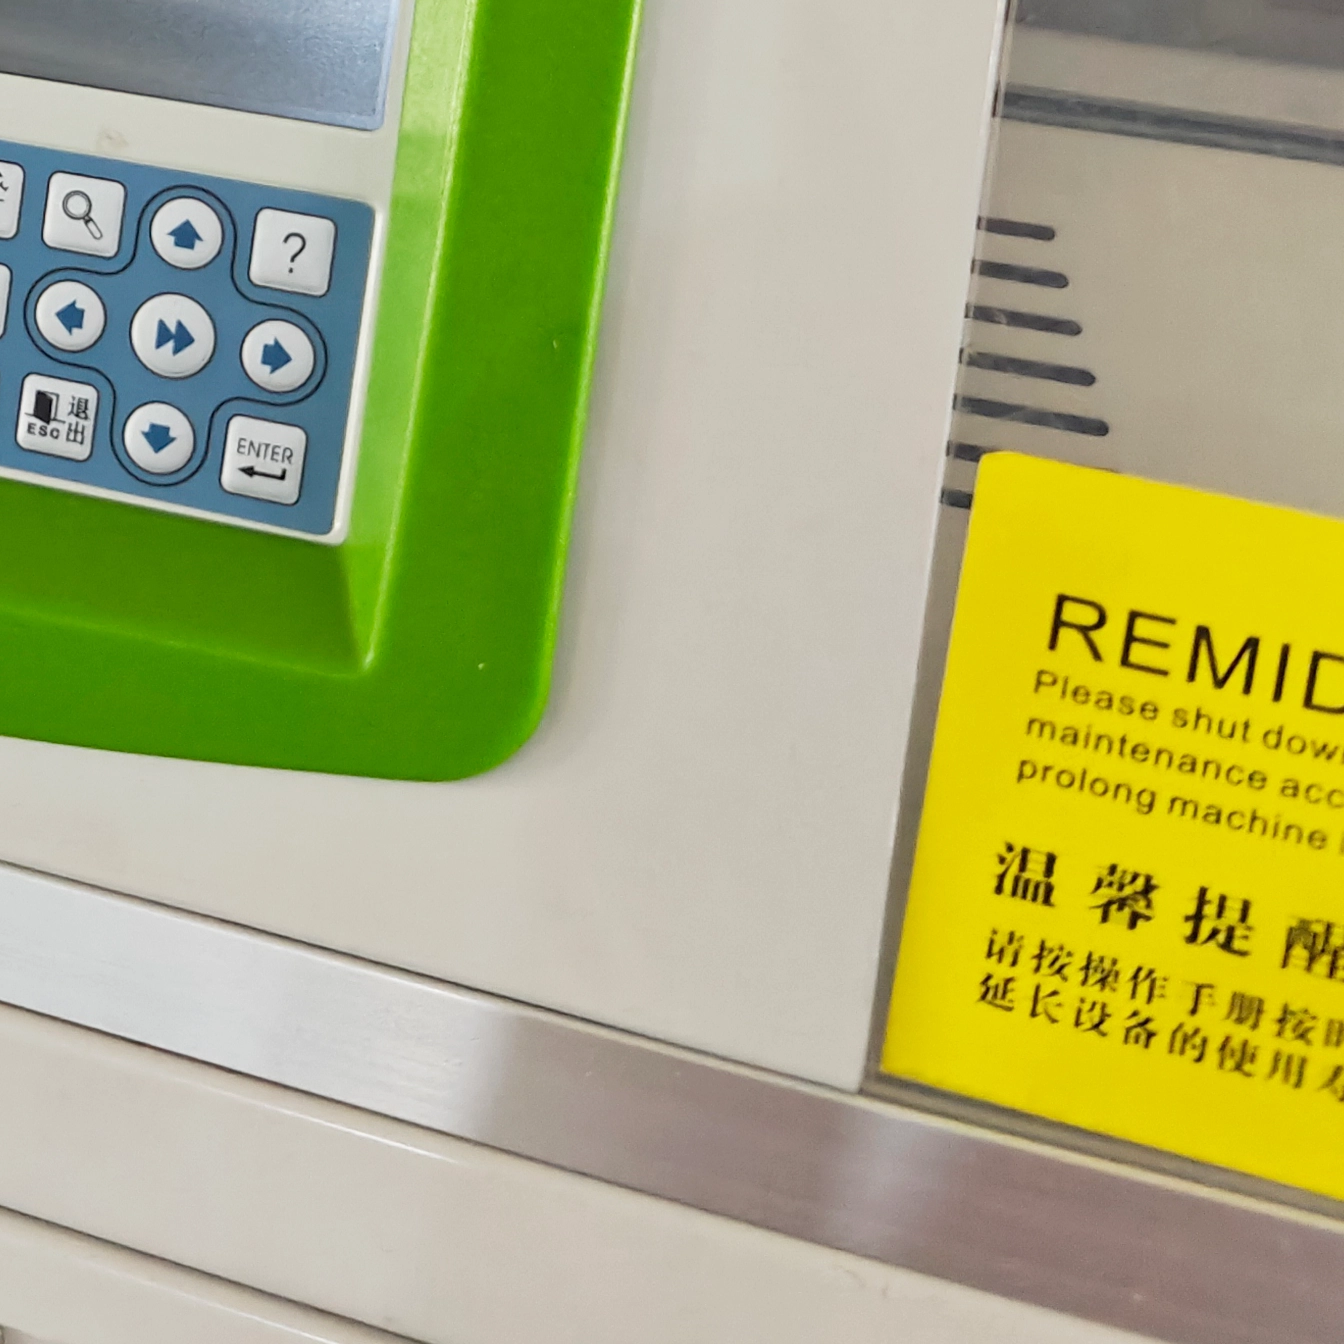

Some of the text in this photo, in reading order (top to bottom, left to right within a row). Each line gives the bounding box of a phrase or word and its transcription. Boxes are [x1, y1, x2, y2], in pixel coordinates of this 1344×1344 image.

[26, 422, 61, 440] ESC
[236, 436, 294, 467] ENTER
[1024, 714, 1268, 791] maintenance
[1033, 668, 1344, 764] Please shut dow
[1015, 756, 1157, 815] prolong
[1166, 794, 1328, 851] machine
